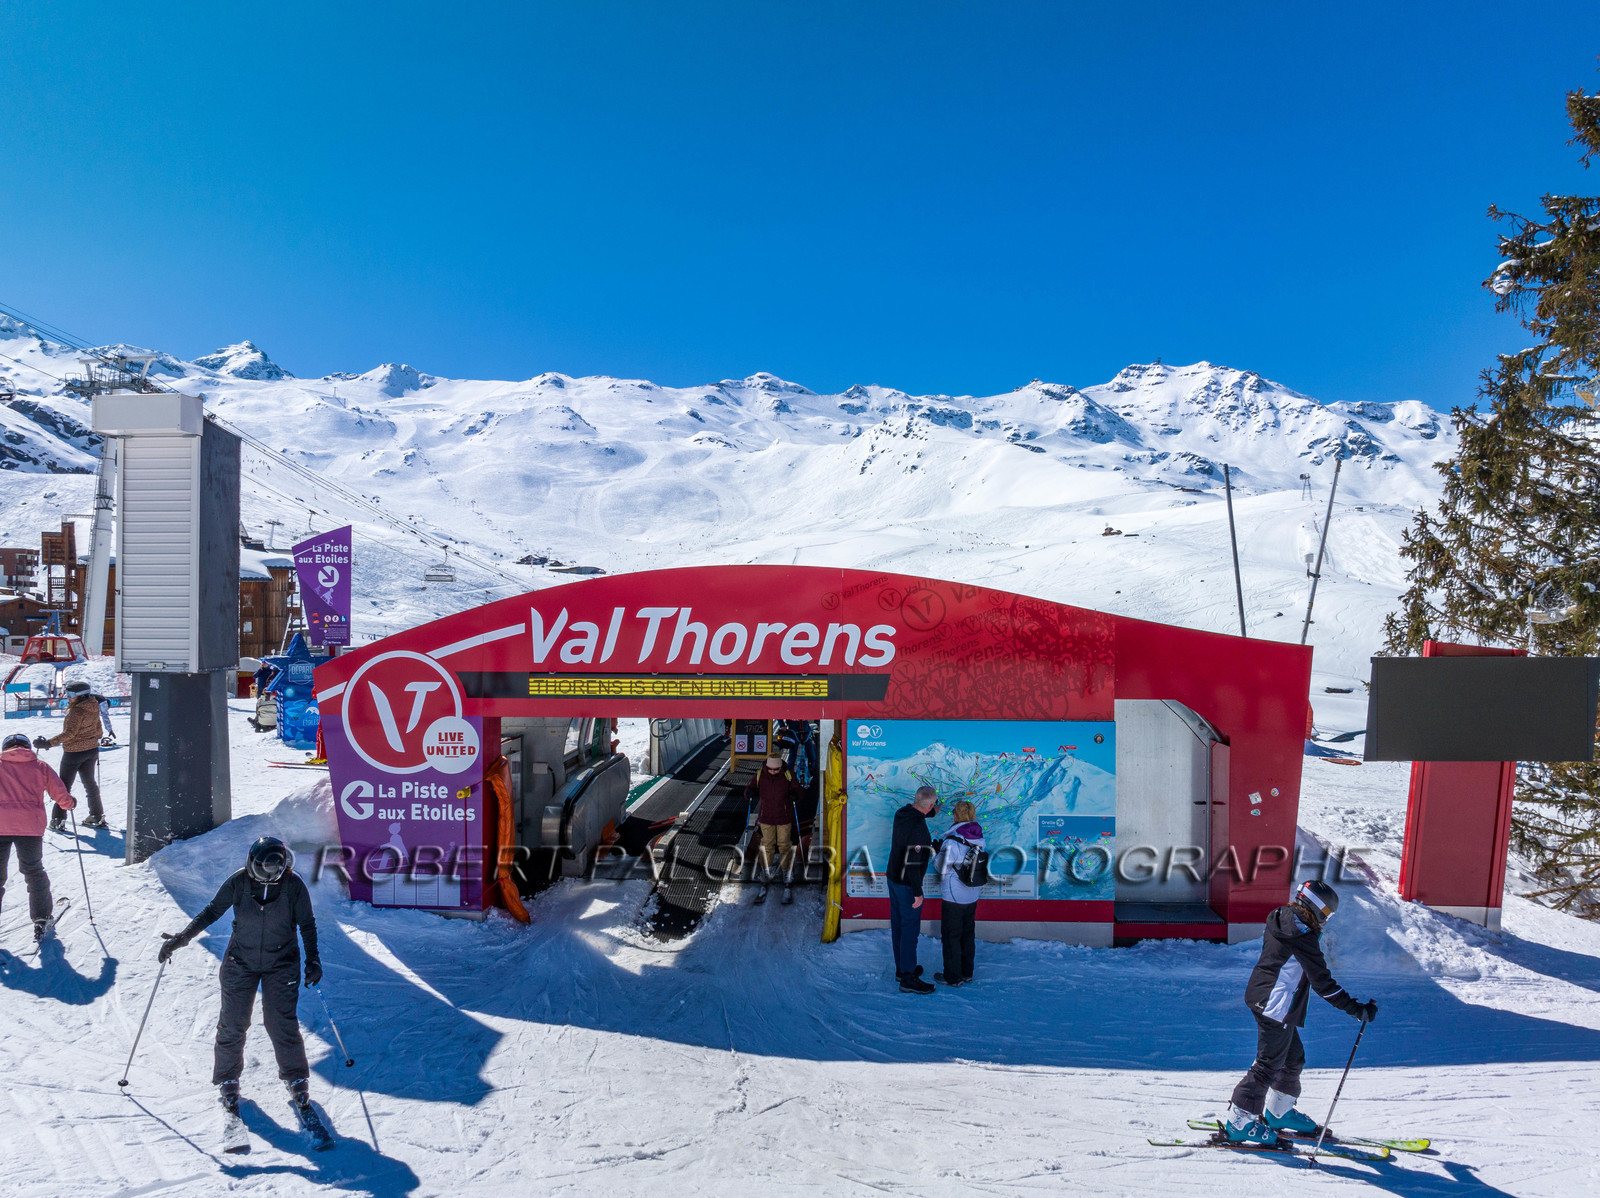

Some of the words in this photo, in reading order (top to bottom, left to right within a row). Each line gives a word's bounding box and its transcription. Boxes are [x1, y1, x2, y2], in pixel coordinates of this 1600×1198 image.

[312, 545, 322, 553] La
[324, 543, 349, 553] Piste
[315, 555, 349, 564] Etoiles
[530, 606, 626, 664] Val
[635, 606, 897, 667] Thorens
[533, 679, 623, 695] THORENS
[629, 680, 646, 695] IS
[652, 680, 703, 695] OPEN
[710, 680, 763, 695] UNTIL
[768, 680, 806, 695] THE
[812, 681, 821, 695] 8
[438, 732, 464, 742] LIVE
[426, 746, 476, 756] UNITED
[378, 784, 396, 798] La
[402, 782, 449, 799] Piste
[378, 808, 406, 821] aux
[411, 803, 476, 822] Etoiles
